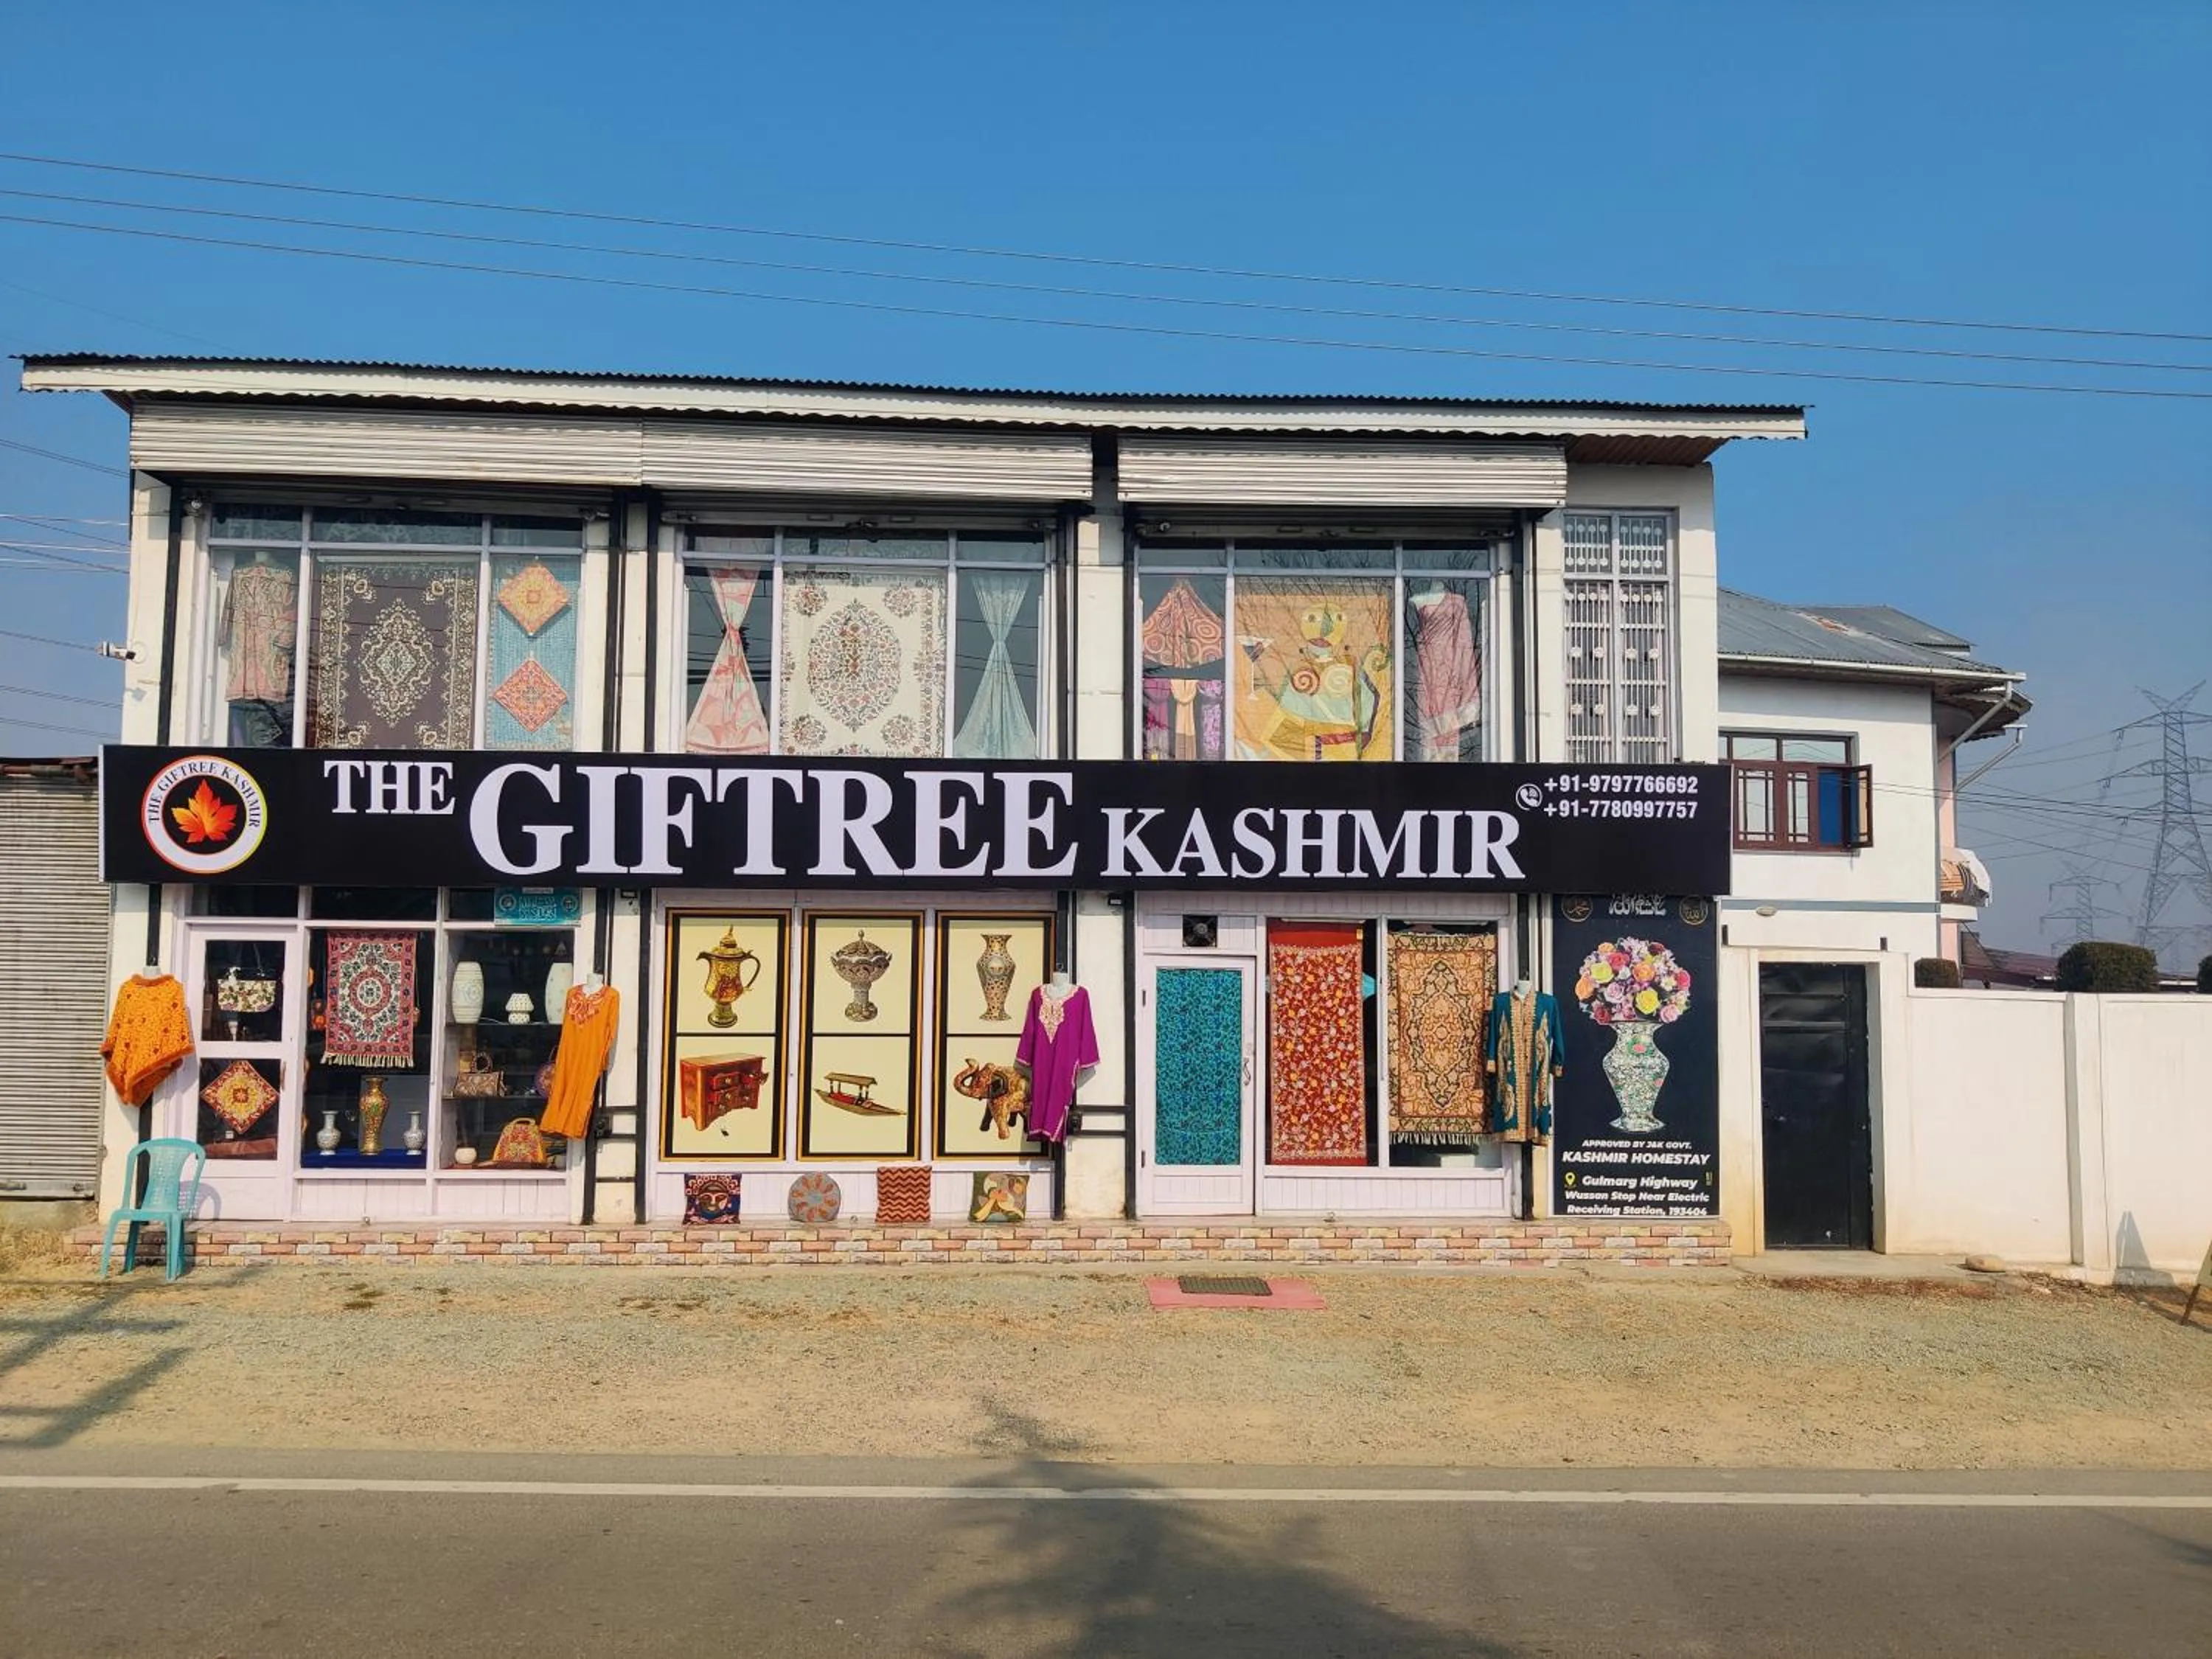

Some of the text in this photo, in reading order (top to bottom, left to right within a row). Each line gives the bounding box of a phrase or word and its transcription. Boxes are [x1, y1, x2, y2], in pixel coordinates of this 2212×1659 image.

[1543, 774, 1698, 794] +91-9797766692
[148, 761, 261, 828] THE GIFTREE KASHMIR
[1543, 799, 1698, 819] +91-7780997757
[323, 759, 1526, 879] THE GIFTREE KASHMIR
[1582, 1139, 1631, 1148] APPROVED
[1646, 1141, 1664, 1149] J&K
[1665, 1141, 1692, 1150] GOVT.
[1562, 1151, 1711, 1164] KASHMIR HOMESTAY
[1582, 1175, 1698, 1189] Gulmarg Highway
[1565, 1190, 1710, 1203] Wussan Stop Near Electric
[1567, 1204, 1707, 1216] Receiving Station, 193404
